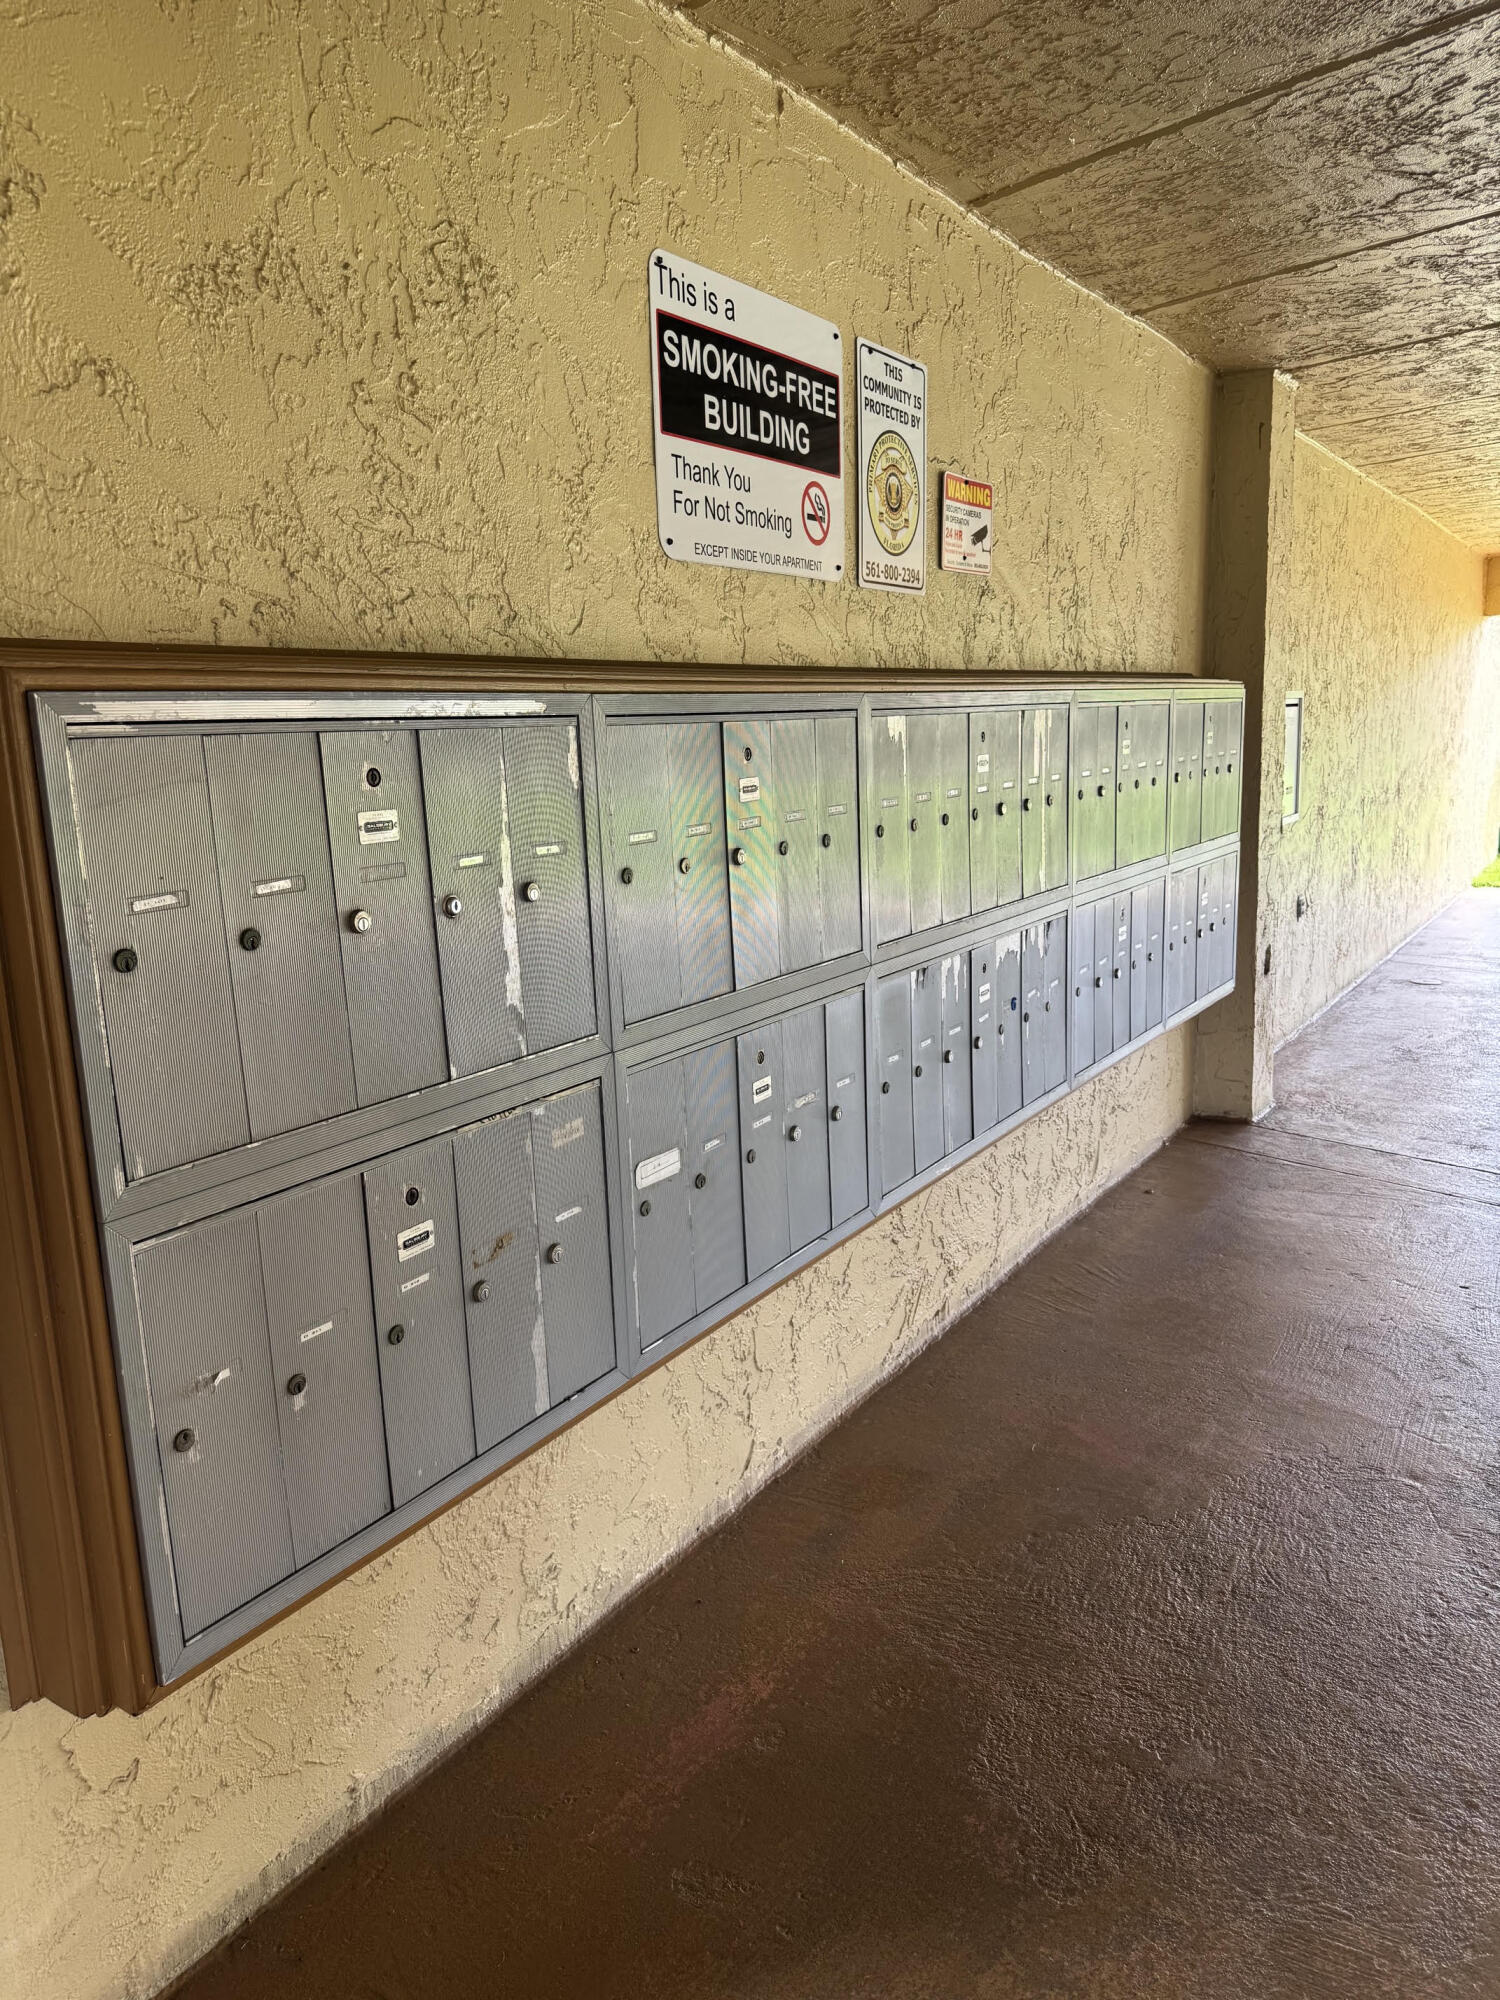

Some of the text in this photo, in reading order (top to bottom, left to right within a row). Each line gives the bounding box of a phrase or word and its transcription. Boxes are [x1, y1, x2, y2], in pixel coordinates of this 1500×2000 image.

[654, 260, 736, 322] This is a
[663, 329, 837, 419] SMOKING-FREE
[884, 362, 903, 383] THIS
[863, 375, 922, 411] COMMUNITY IS
[703, 393, 810, 455] BUILDING
[864, 400, 921, 430] PROTECTED BY
[671, 453, 751, 493] Thank You
[948, 478, 991, 507] WARNING
[673, 490, 792, 539] For Not Smoking
[963, 508, 982, 520] CAMERAS
[946, 527, 963, 542] 24 HR
[694, 542, 823, 573] EXCEPT INSIDE YOUR APARTMENT
[865, 560, 920, 585] 561-800-2394
